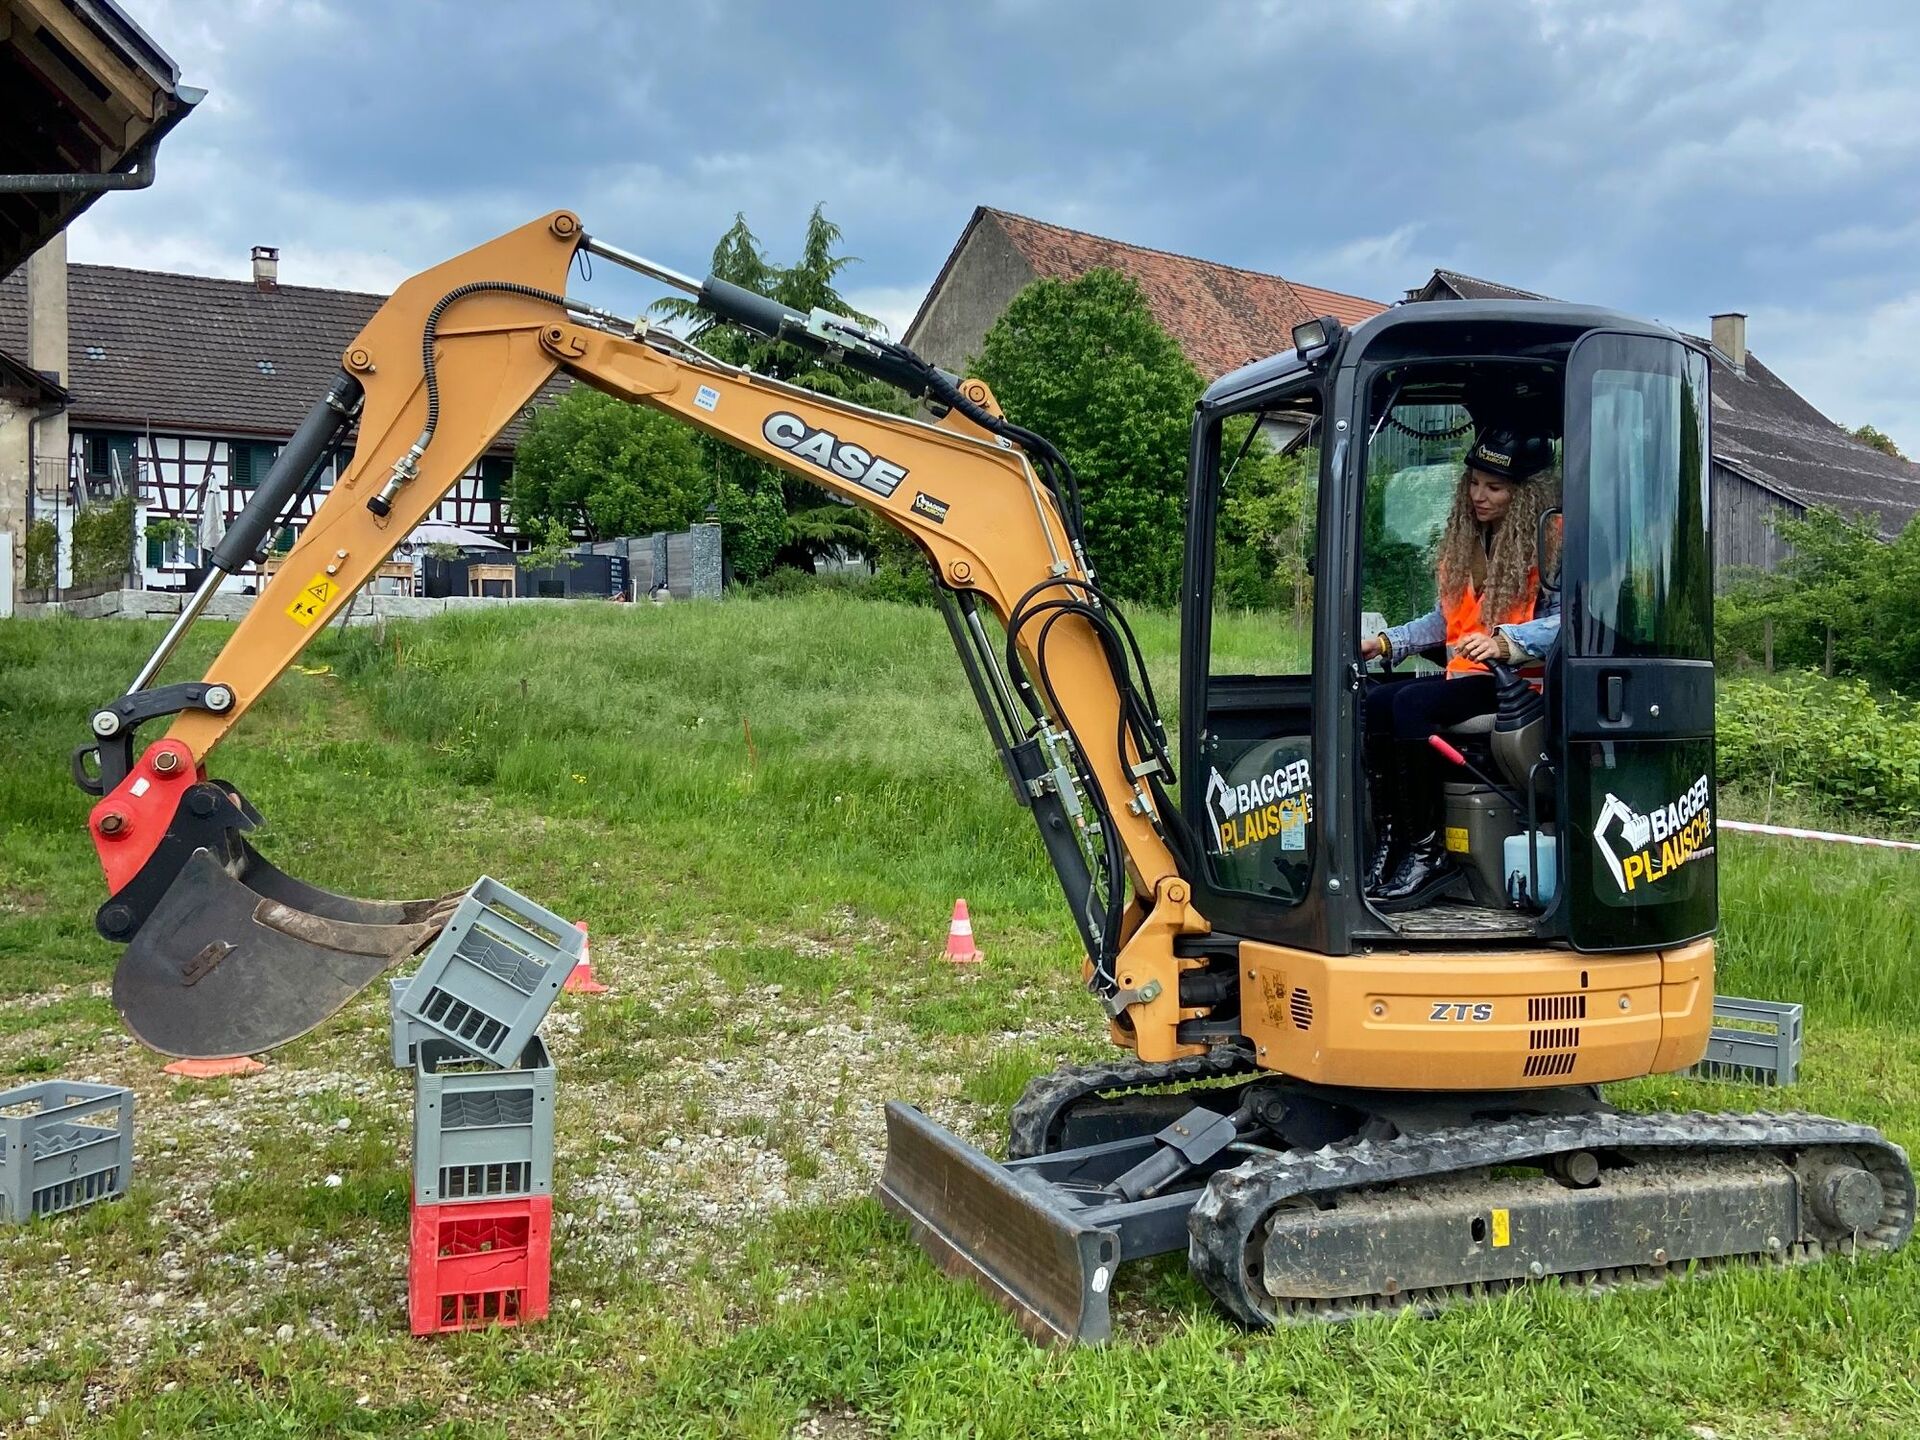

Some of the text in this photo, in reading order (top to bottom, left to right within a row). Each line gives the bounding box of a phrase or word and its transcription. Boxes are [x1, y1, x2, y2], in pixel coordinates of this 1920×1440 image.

[763, 412, 908, 497] CASE
[1237, 758, 1312, 814] BAGGER
[1650, 774, 1709, 843] BAGGER
[1221, 792, 1309, 854] PLAUSCH
[1623, 810, 1707, 891] PLAUSCH
[1429, 1001, 1493, 1022] ZTS
